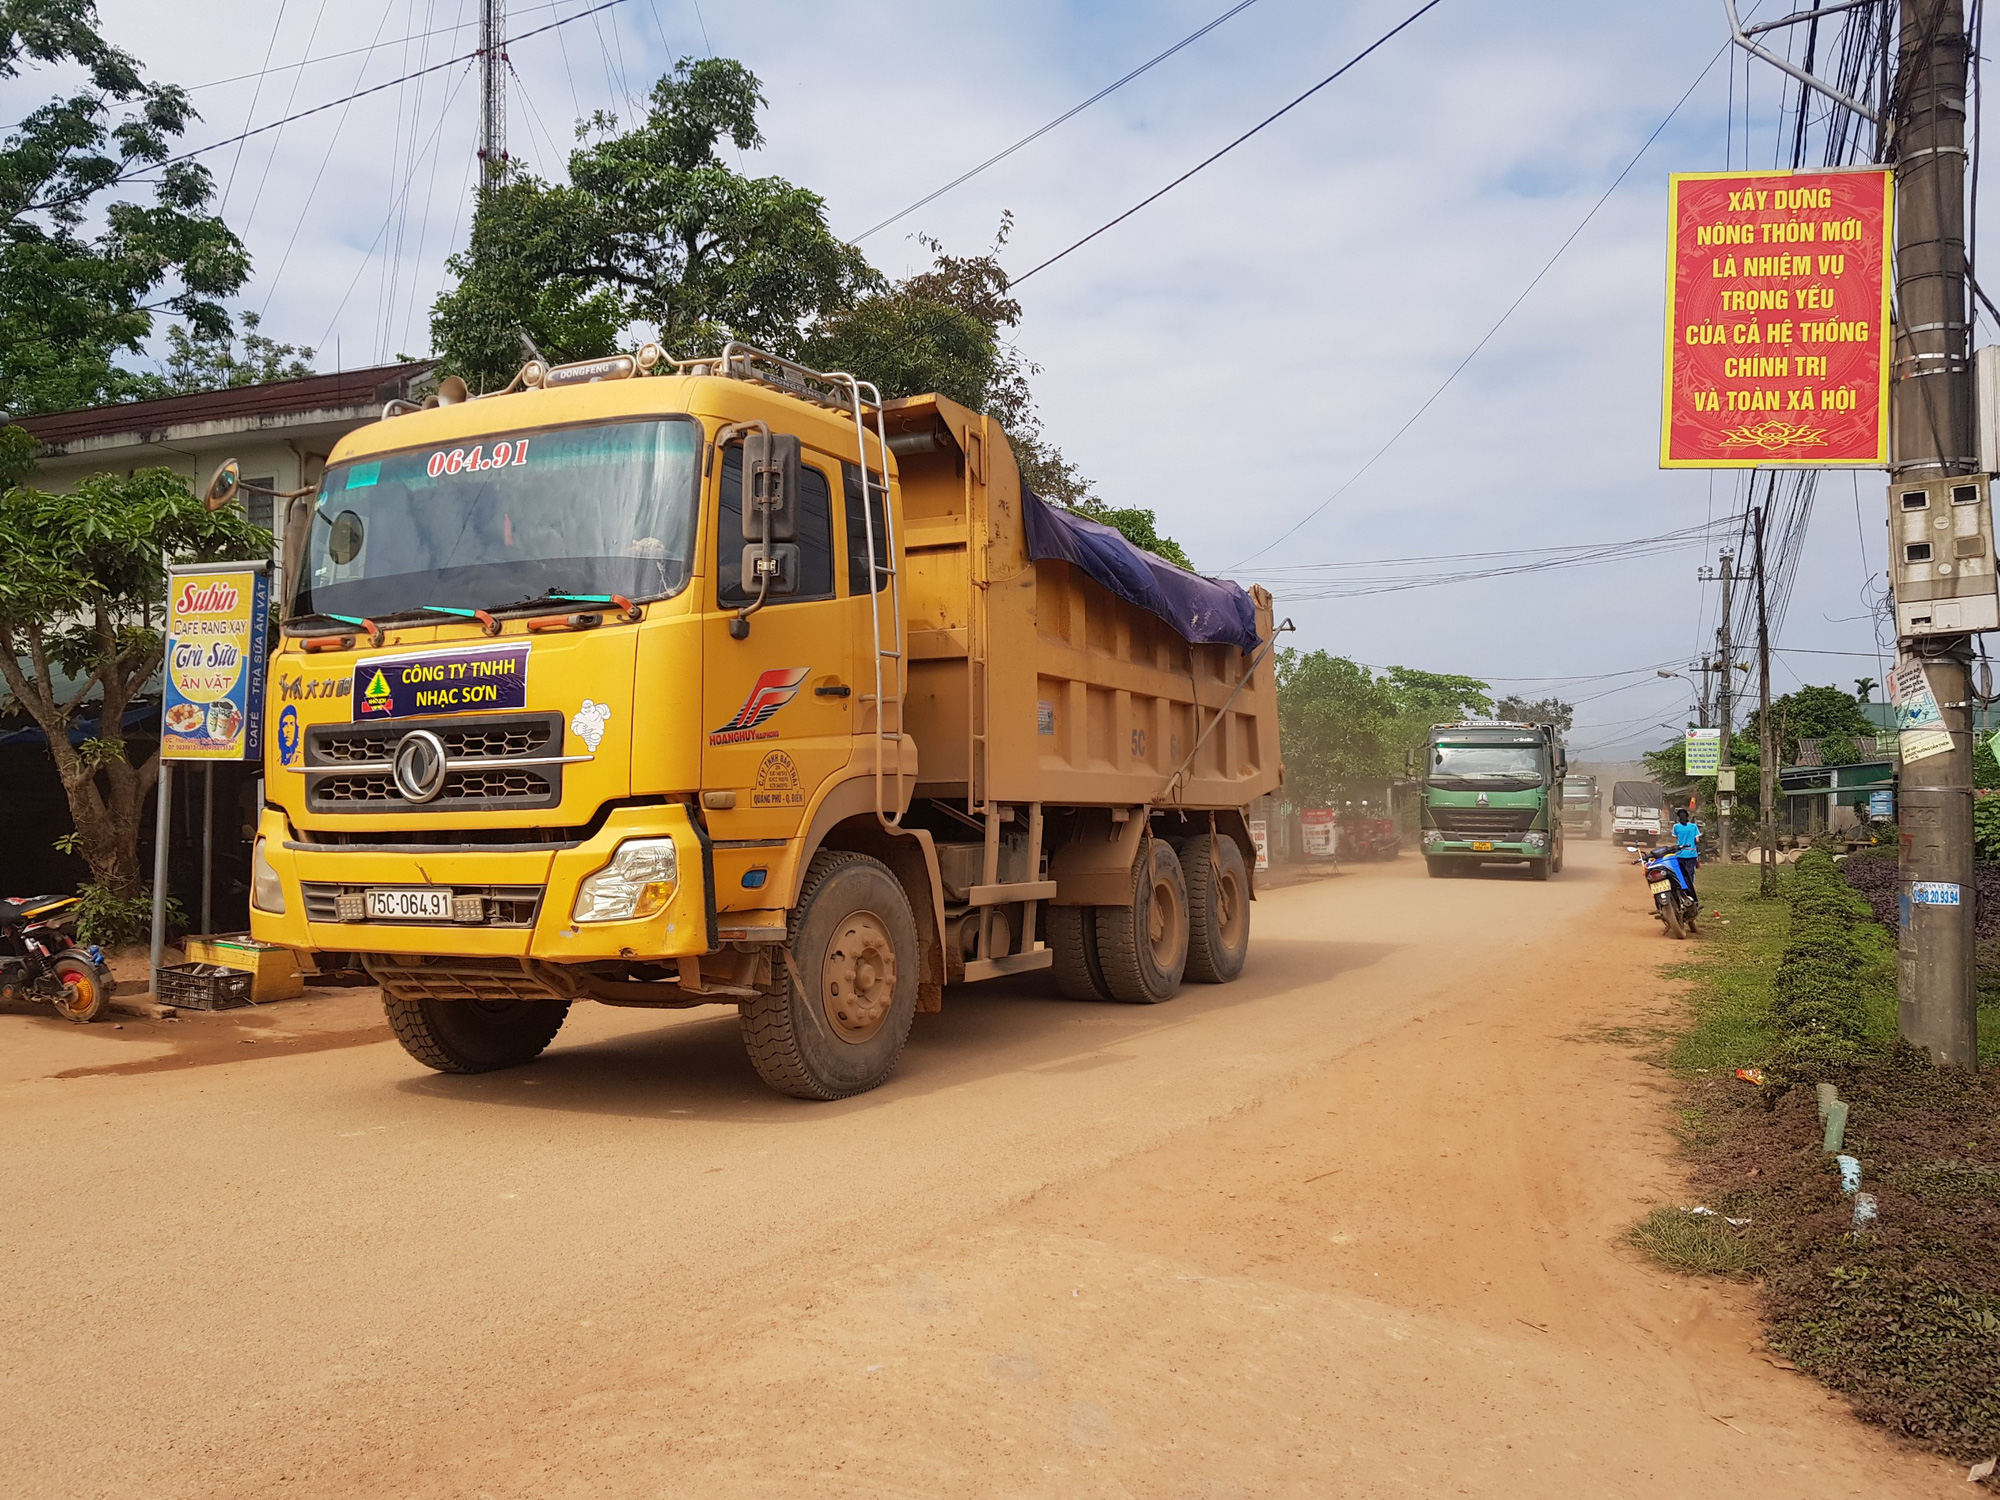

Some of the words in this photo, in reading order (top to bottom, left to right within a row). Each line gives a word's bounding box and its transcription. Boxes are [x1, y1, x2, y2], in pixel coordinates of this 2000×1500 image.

[1728, 187, 1768, 211] XÂY
[1774, 187, 1831, 213] DỰNG
[1697, 221, 1754, 246] NÔNG
[1761, 219, 1815, 243] THÔN
[1821, 217, 1862, 242] MỚI
[1712, 254, 1739, 278] LÀ
[1743, 252, 1811, 282] NHIỆM
[1818, 254, 1845, 279] VỤ
[1721, 290, 1788, 315] TRỌNG
[1795, 282, 1834, 309] YẾU
[1686, 318, 1726, 346] CỦA
[1733, 316, 1760, 344] CẢ
[1767, 320, 1793, 347] HỆ
[1799, 315, 1869, 343] THỐNG
[560, 364, 609, 379] DONGFENG
[1724, 352, 1788, 378] CHÍNH
[1795, 356, 1827, 381] TRỊ
[1694, 388, 1720, 412] VÀ
[1726, 386, 1780, 411] TOÀN
[1786, 386, 1815, 410] XÃ
[1821, 385, 1856, 414] HỘI
[427, 439, 529, 478] 064.91
[177, 583, 236, 613] Subin
[257, 583, 267, 609] VẶT
[202, 621, 227, 634] RANG
[229, 621, 246, 633] XAY
[255, 614, 264, 632] ĂN
[176, 644, 203, 668] Trà
[207, 642, 237, 667] Sữa
[254, 636, 263, 663] SỮA
[180, 675, 200, 689] ĂN
[205, 674, 231, 692] VẶT
[252, 668, 261, 694] TRÀ
[402, 664, 444, 684] CÔNG
[448, 663, 467, 679] TY
[471, 659, 515, 677] TNHH
[416, 688, 458, 708] NHẠC
[462, 685, 497, 702] SƠN
[249, 712, 258, 747] CAFÉ
[709, 730, 756, 745] HOANGHUY
[764, 754, 778, 768] TNHH
[368, 893, 449, 915] 75C-064.91
